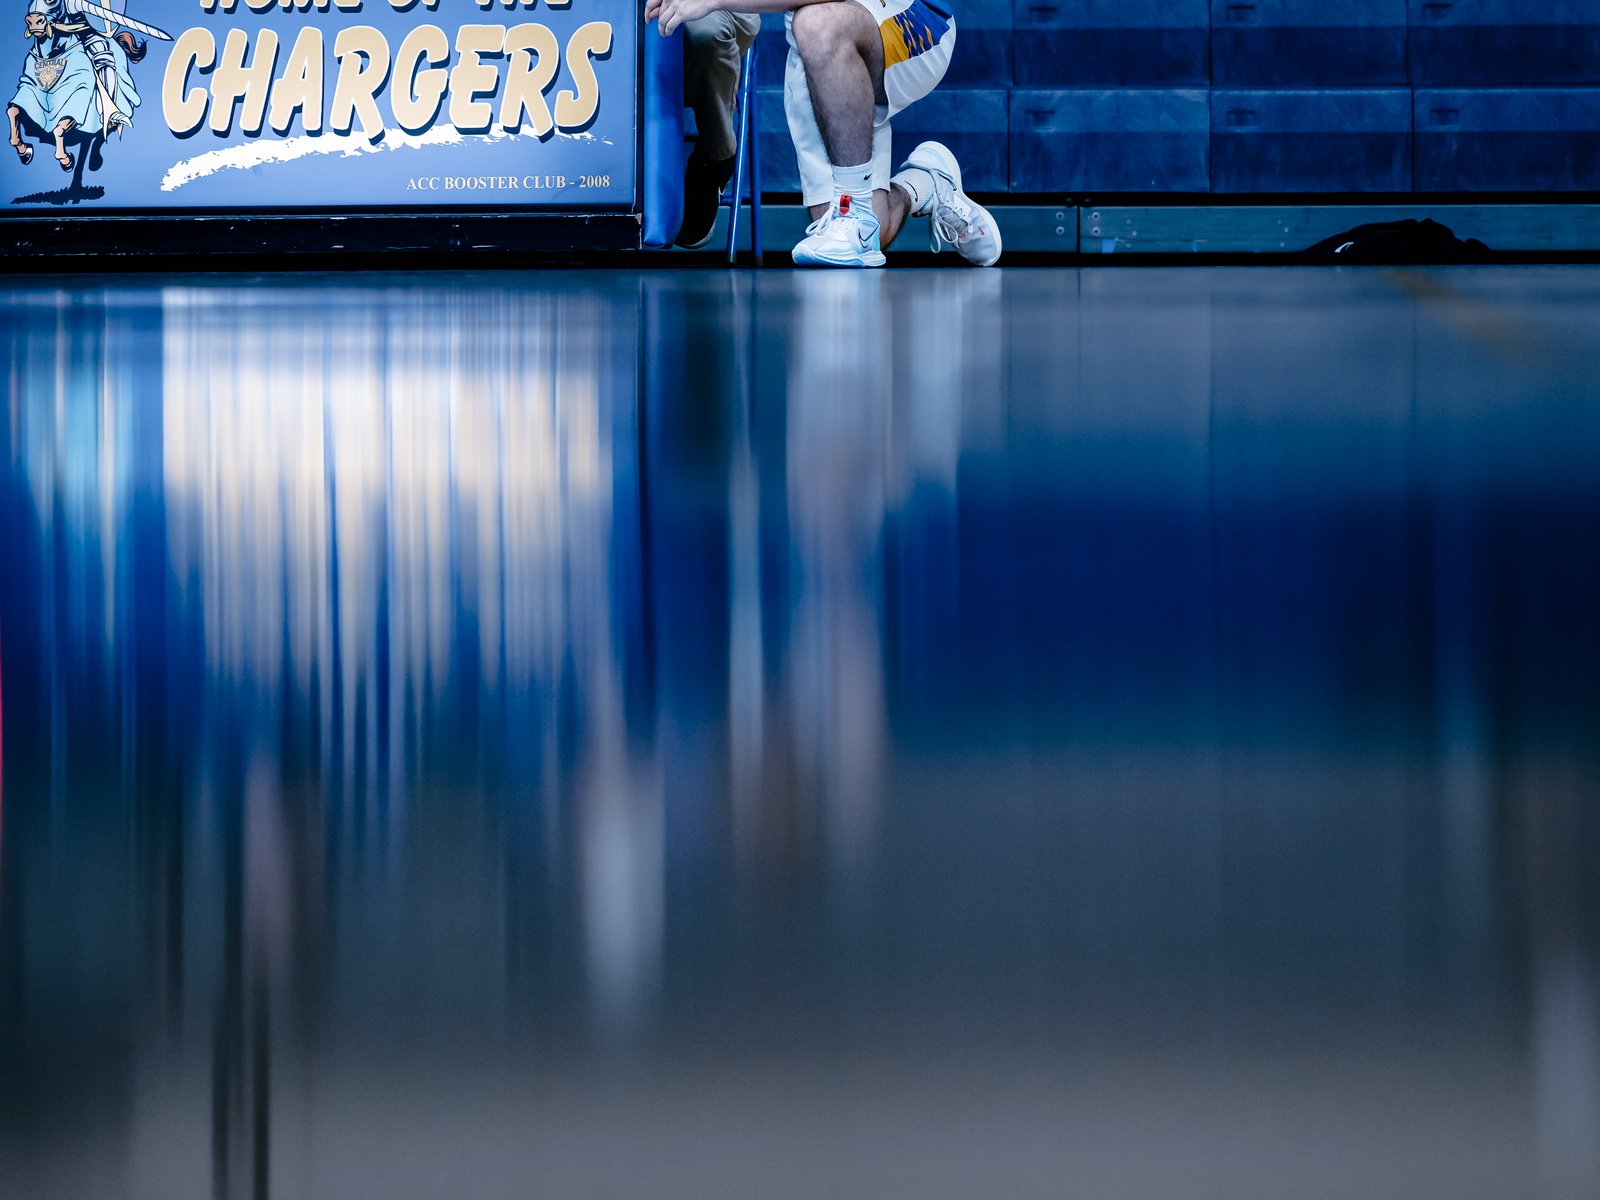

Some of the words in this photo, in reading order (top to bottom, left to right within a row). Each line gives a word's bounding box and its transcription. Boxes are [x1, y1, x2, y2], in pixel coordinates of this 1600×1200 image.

[161, 22, 613, 144] CHARGERS
[406, 177, 440, 190] ACC
[444, 176, 519, 190] BOOSTER
[522, 175, 567, 189] CLUB
[579, 175, 611, 188] 2008
